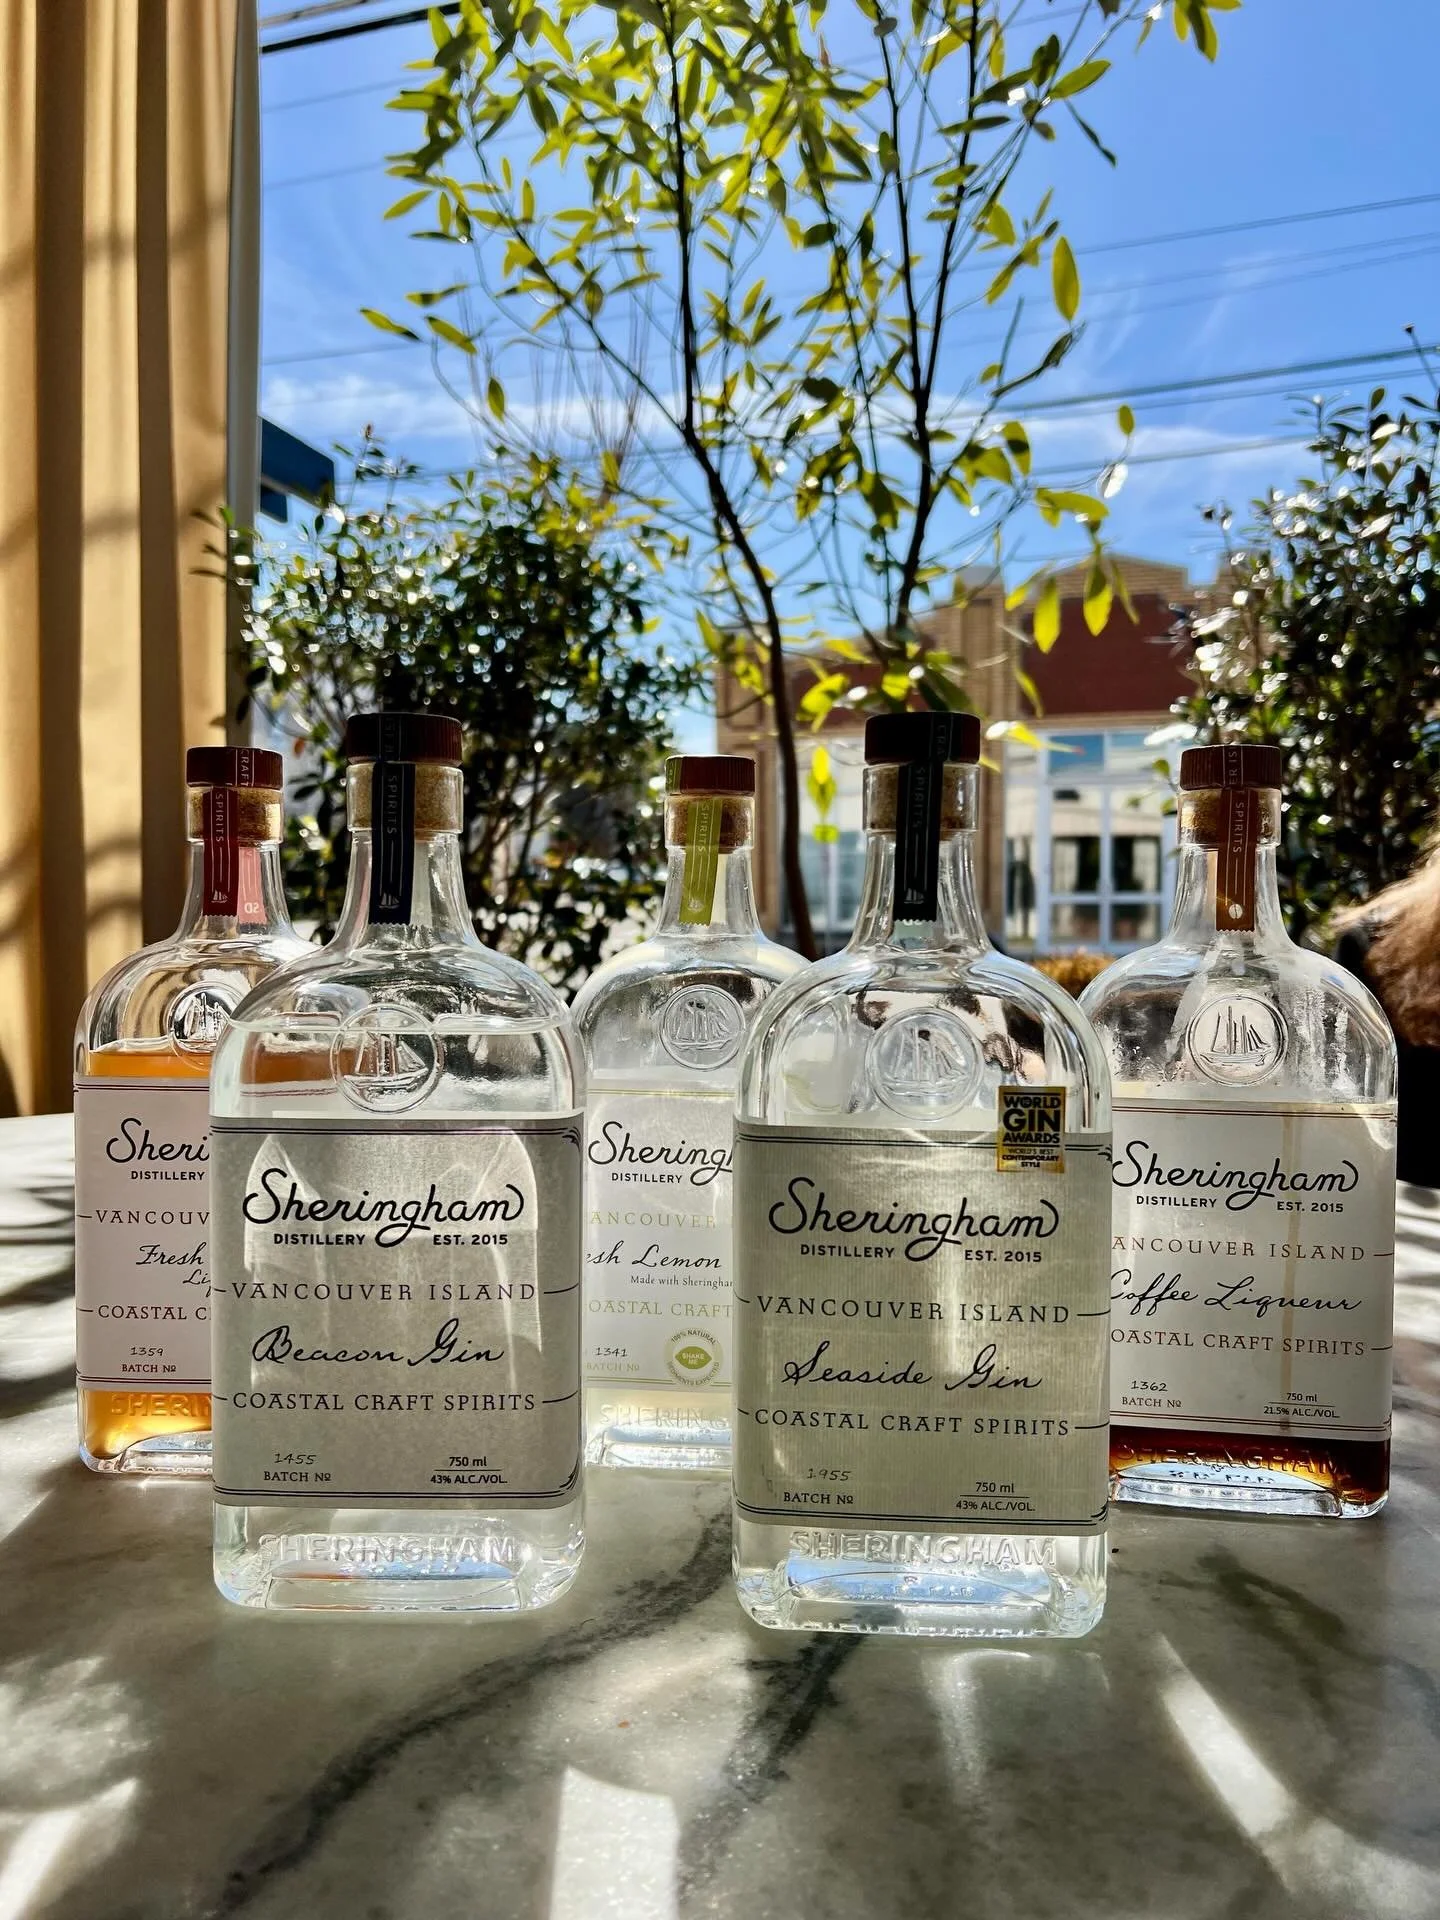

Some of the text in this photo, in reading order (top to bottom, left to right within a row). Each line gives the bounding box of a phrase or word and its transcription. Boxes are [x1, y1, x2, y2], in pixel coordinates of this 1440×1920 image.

[386, 775, 397, 834] SPIRITS
[215, 792, 225, 842] SPIRITS
[698, 803, 710, 853] SPIRITS
[1233, 801, 1245, 853] SPIRITS
[1003, 1095, 1061, 1108] WORLD
[1003, 1109, 1061, 1132] GIN
[1003, 1132, 1060, 1143] AWARDS
[131, 1170, 205, 1181] DISTILLERY
[611, 1172, 682, 1184] DISTILLERY
[1112, 1140, 1359, 1211] Sheringham
[242, 1167, 525, 1248] Sheringham
[1136, 1195, 1344, 1213] DISTILLERY EST. 2015
[768, 1176, 1060, 1262] Sheringham
[273, 1233, 508, 1246] DISTILLERY EST. 2015
[135, 1242, 207, 1266] Fresh
[632, 1244, 721, 1269] Lemon
[800, 1244, 1042, 1263] DISTILLERY EST. 2015
[1270, 1243, 1365, 1260] ISLAND
[630, 1274, 655, 1285] Made
[658, 1274, 679, 1285] with
[232, 1282, 536, 1301] VANCOUVER ISLAND
[1111, 1268, 1362, 1318] Coffee Liqueur
[97, 1305, 188, 1321] COASTAL
[671, 1302, 733, 1317] CRAFT
[757, 1295, 1070, 1323] VANCOUVER ISLAND
[251, 1317, 505, 1367] Beacon Gin
[671, 1329, 717, 1345] 100% NATURAL
[1203, 1333, 1274, 1351] CRAFT
[1282, 1338, 1365, 1356] SPIRITS
[130, 1346, 164, 1357] 1359
[594, 1347, 628, 1358] 1341
[681, 1352, 705, 1360] SHAKE
[121, 1363, 159, 1373] BATCH
[586, 1362, 622, 1371] BATCH
[781, 1340, 1043, 1390] Seaside Gin
[1130, 1380, 1168, 1392] 1362
[232, 1392, 536, 1411] COASTAL CRAFT SPIRITS
[1122, 1396, 1162, 1408] BATCH
[1286, 1392, 1318, 1402] 750 ml
[1263, 1406, 1290, 1416] 21.5%
[755, 1408, 1069, 1436] COASTAL CRAFT SPIRITS
[274, 1452, 317, 1465] 1455
[449, 1456, 487, 1467] 750 ml
[263, 1470, 309, 1482] BATCH
[430, 1474, 452, 1484] 43%
[975, 1482, 1015, 1493] 750 ml
[783, 1491, 831, 1505] BATCH
[956, 1500, 978, 1511] 43%
[258, 1533, 517, 1563] SHERINGHAM
[789, 1530, 1057, 1566] SHERINGHAM
